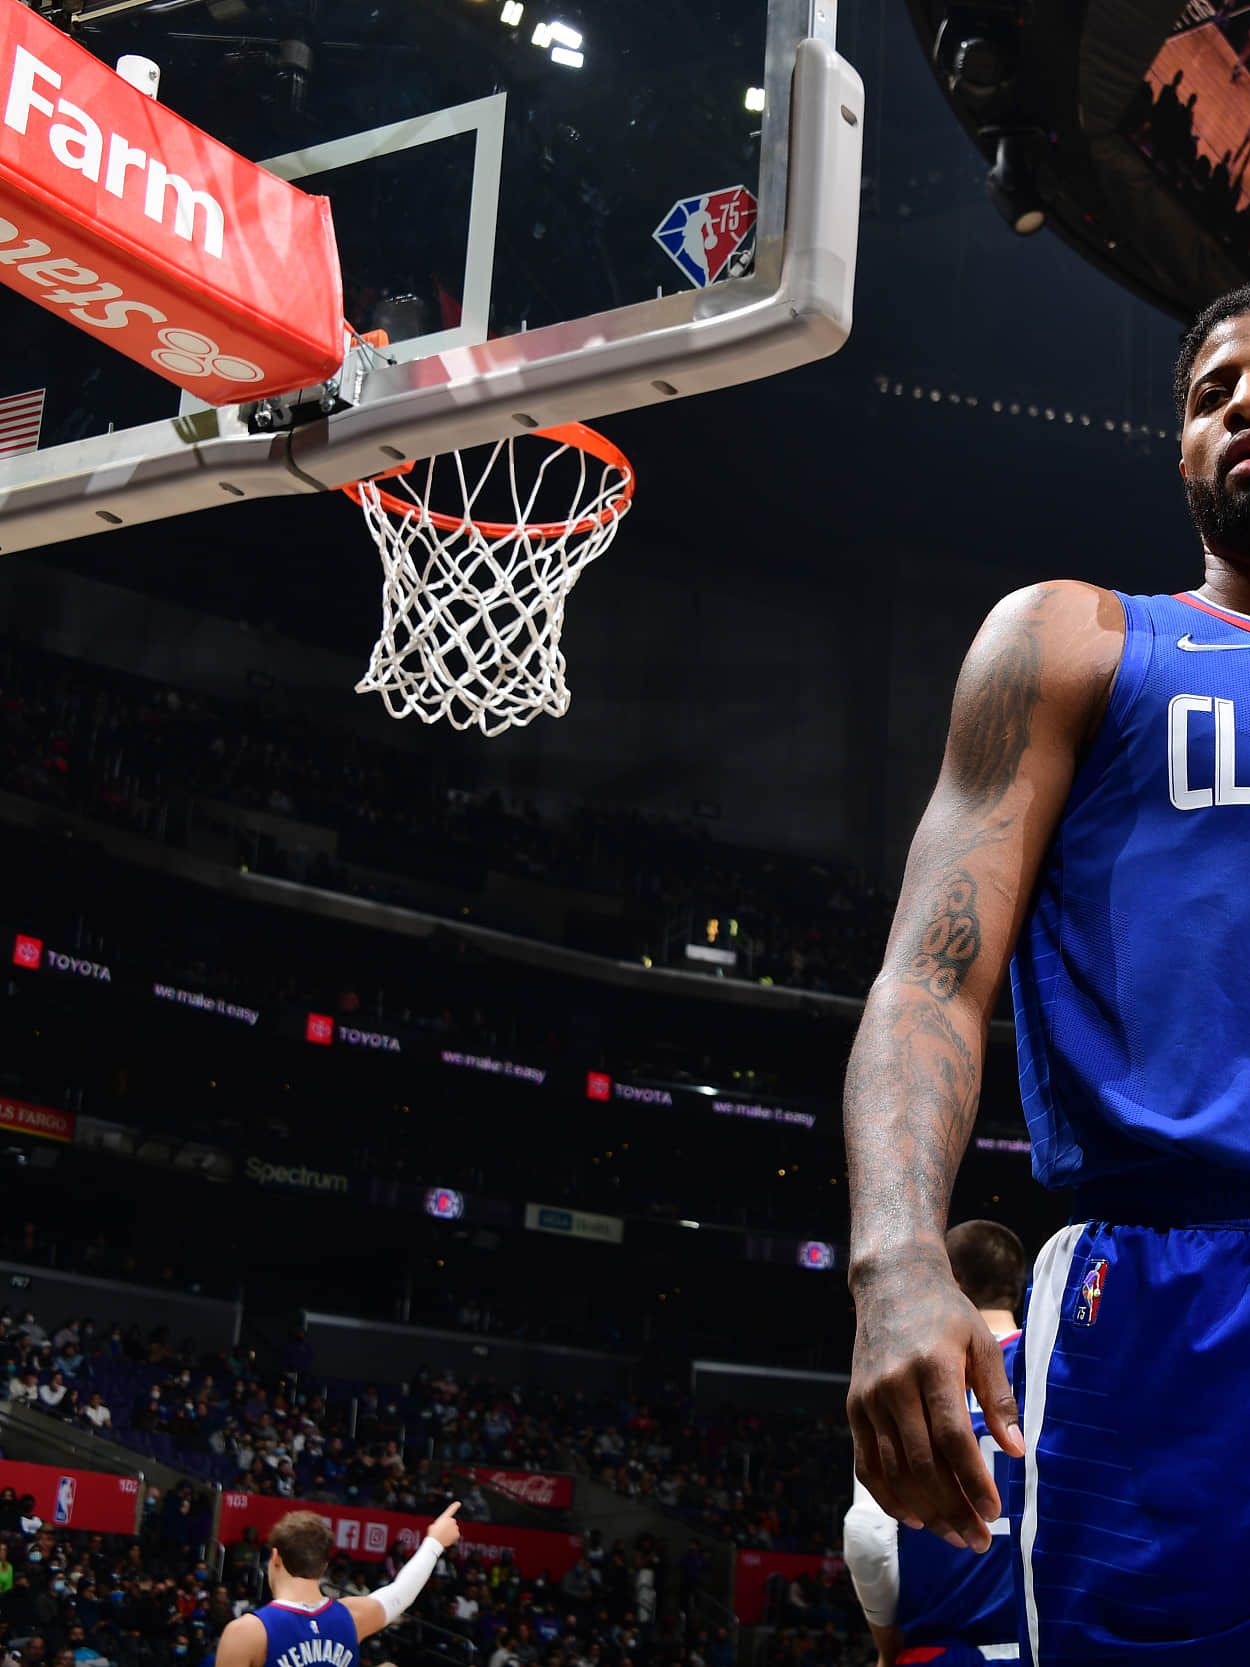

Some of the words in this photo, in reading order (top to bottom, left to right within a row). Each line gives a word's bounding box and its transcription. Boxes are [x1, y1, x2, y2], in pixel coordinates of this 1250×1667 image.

[4, 45, 224, 259] Farm
[719, 201, 740, 233] 75
[0, 217, 167, 329] Stat
[47, 948, 112, 983] TOYOTA
[337, 1024, 401, 1053] TOYOTA
[614, 1082, 672, 1107] TOYOTA
[19, 1107, 68, 1129] FARGO
[245, 1156, 349, 1192] Spectrum
